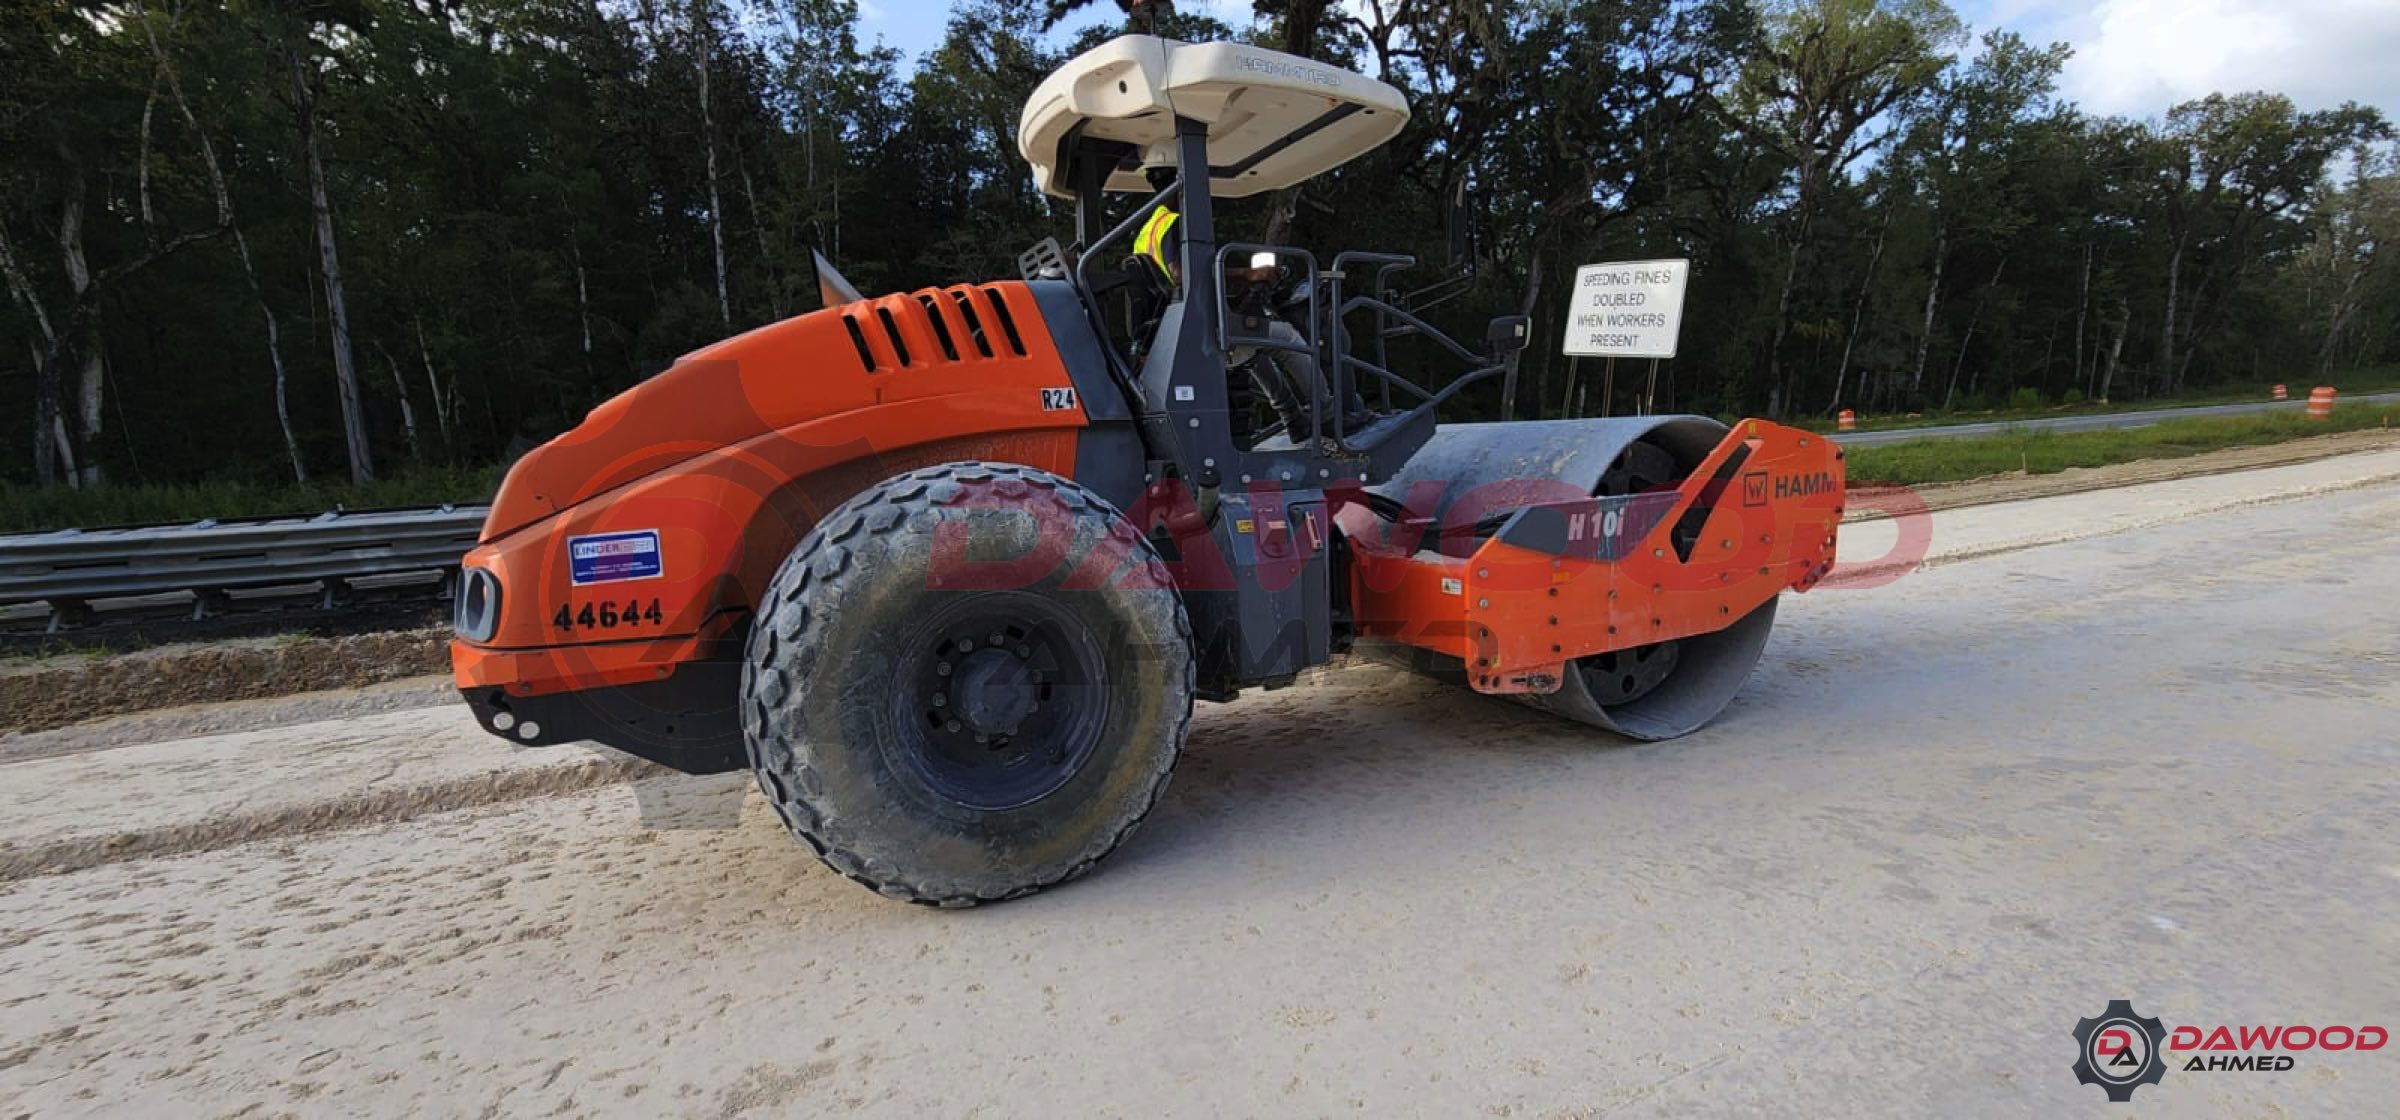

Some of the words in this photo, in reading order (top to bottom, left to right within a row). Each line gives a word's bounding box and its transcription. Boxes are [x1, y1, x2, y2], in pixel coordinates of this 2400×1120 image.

[1584, 273, 1630, 286] SPEEDING
[1635, 270, 1672, 284] FINES
[1593, 292, 1645, 306] DOUBLED
[1578, 314, 1602, 327] WHEN
[1608, 313, 1666, 327] WORKERS
[1591, 334, 1639, 347] PRESENT
[1042, 389, 1074, 409] R24
[1775, 472, 1836, 498] HAMM
[1568, 513, 1585, 541] H
[1591, 507, 1625, 538] 10i
[553, 597, 662, 631] 44644
